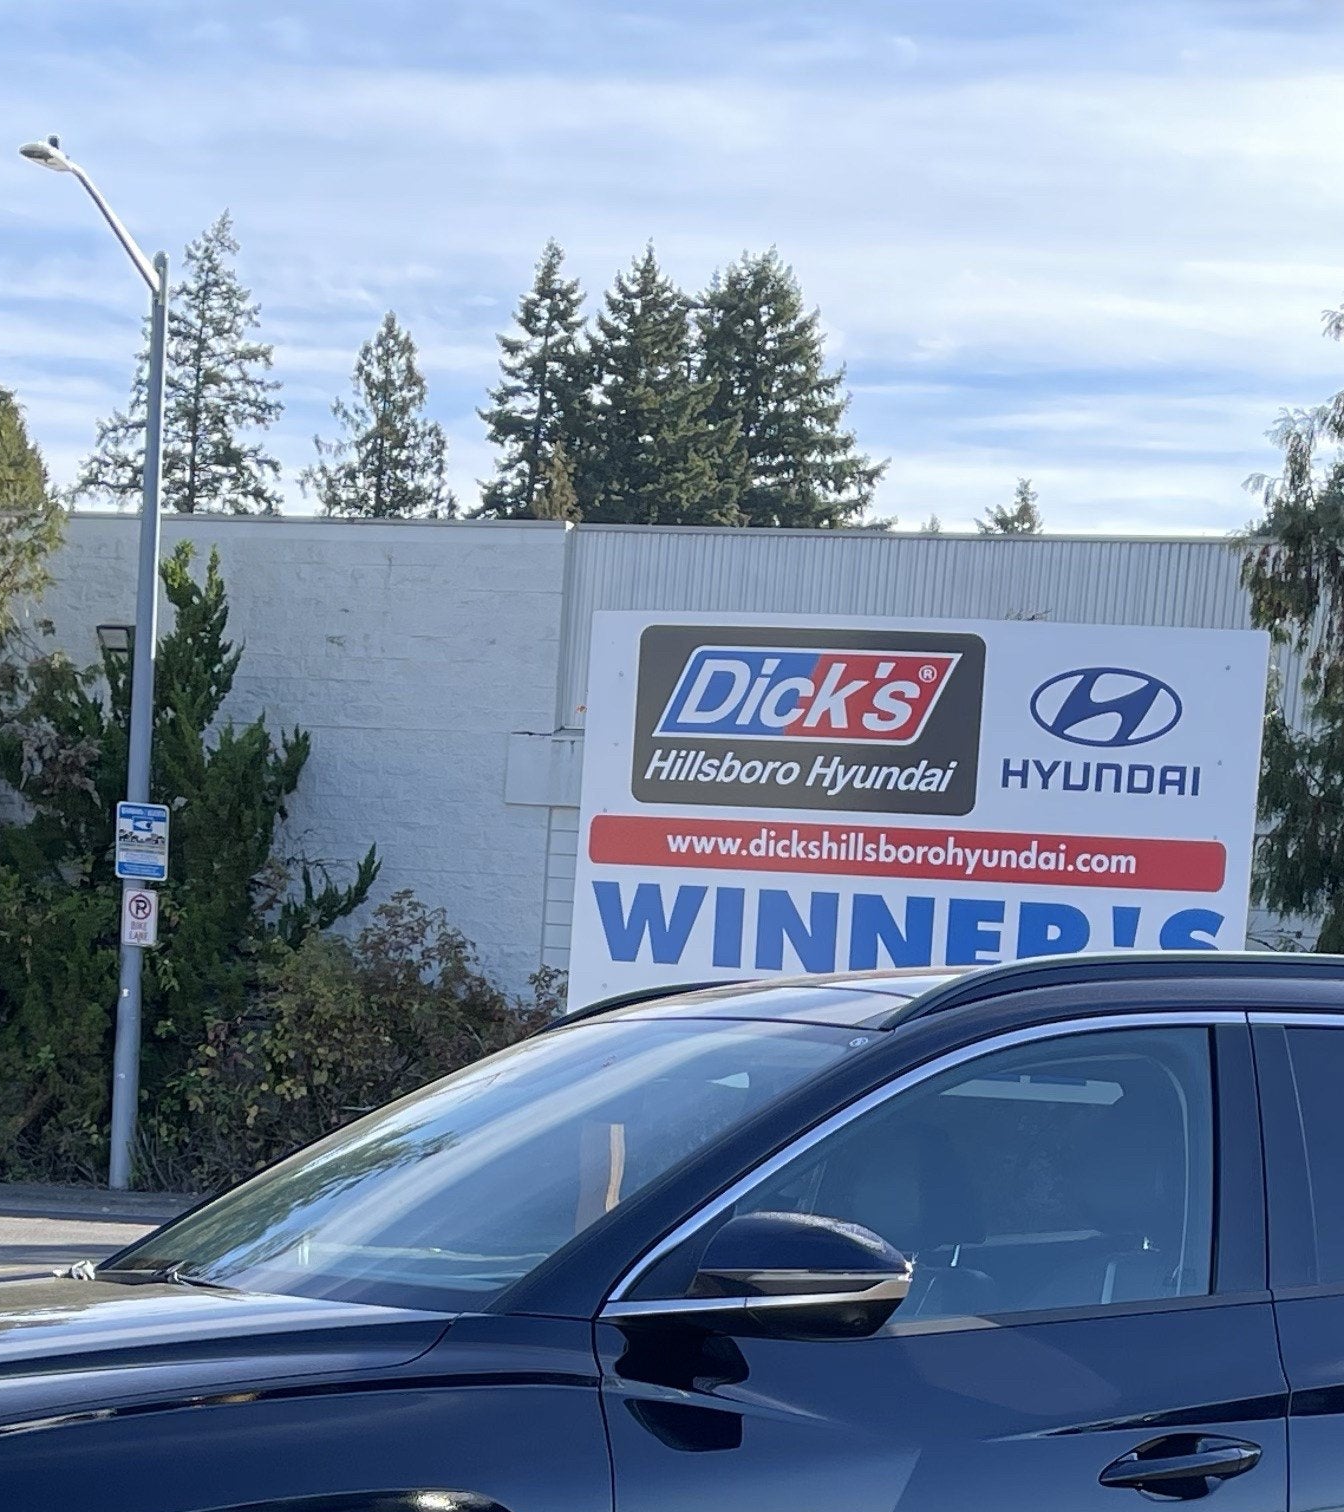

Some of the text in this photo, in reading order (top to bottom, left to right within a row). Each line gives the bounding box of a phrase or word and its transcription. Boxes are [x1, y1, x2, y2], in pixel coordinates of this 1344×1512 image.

[644, 749, 958, 796] Hillsboro Hyundai
[1000, 757, 1201, 797] HYUNDAI
[666, 827, 1137, 875] www.dickshillsborohyundai.com
